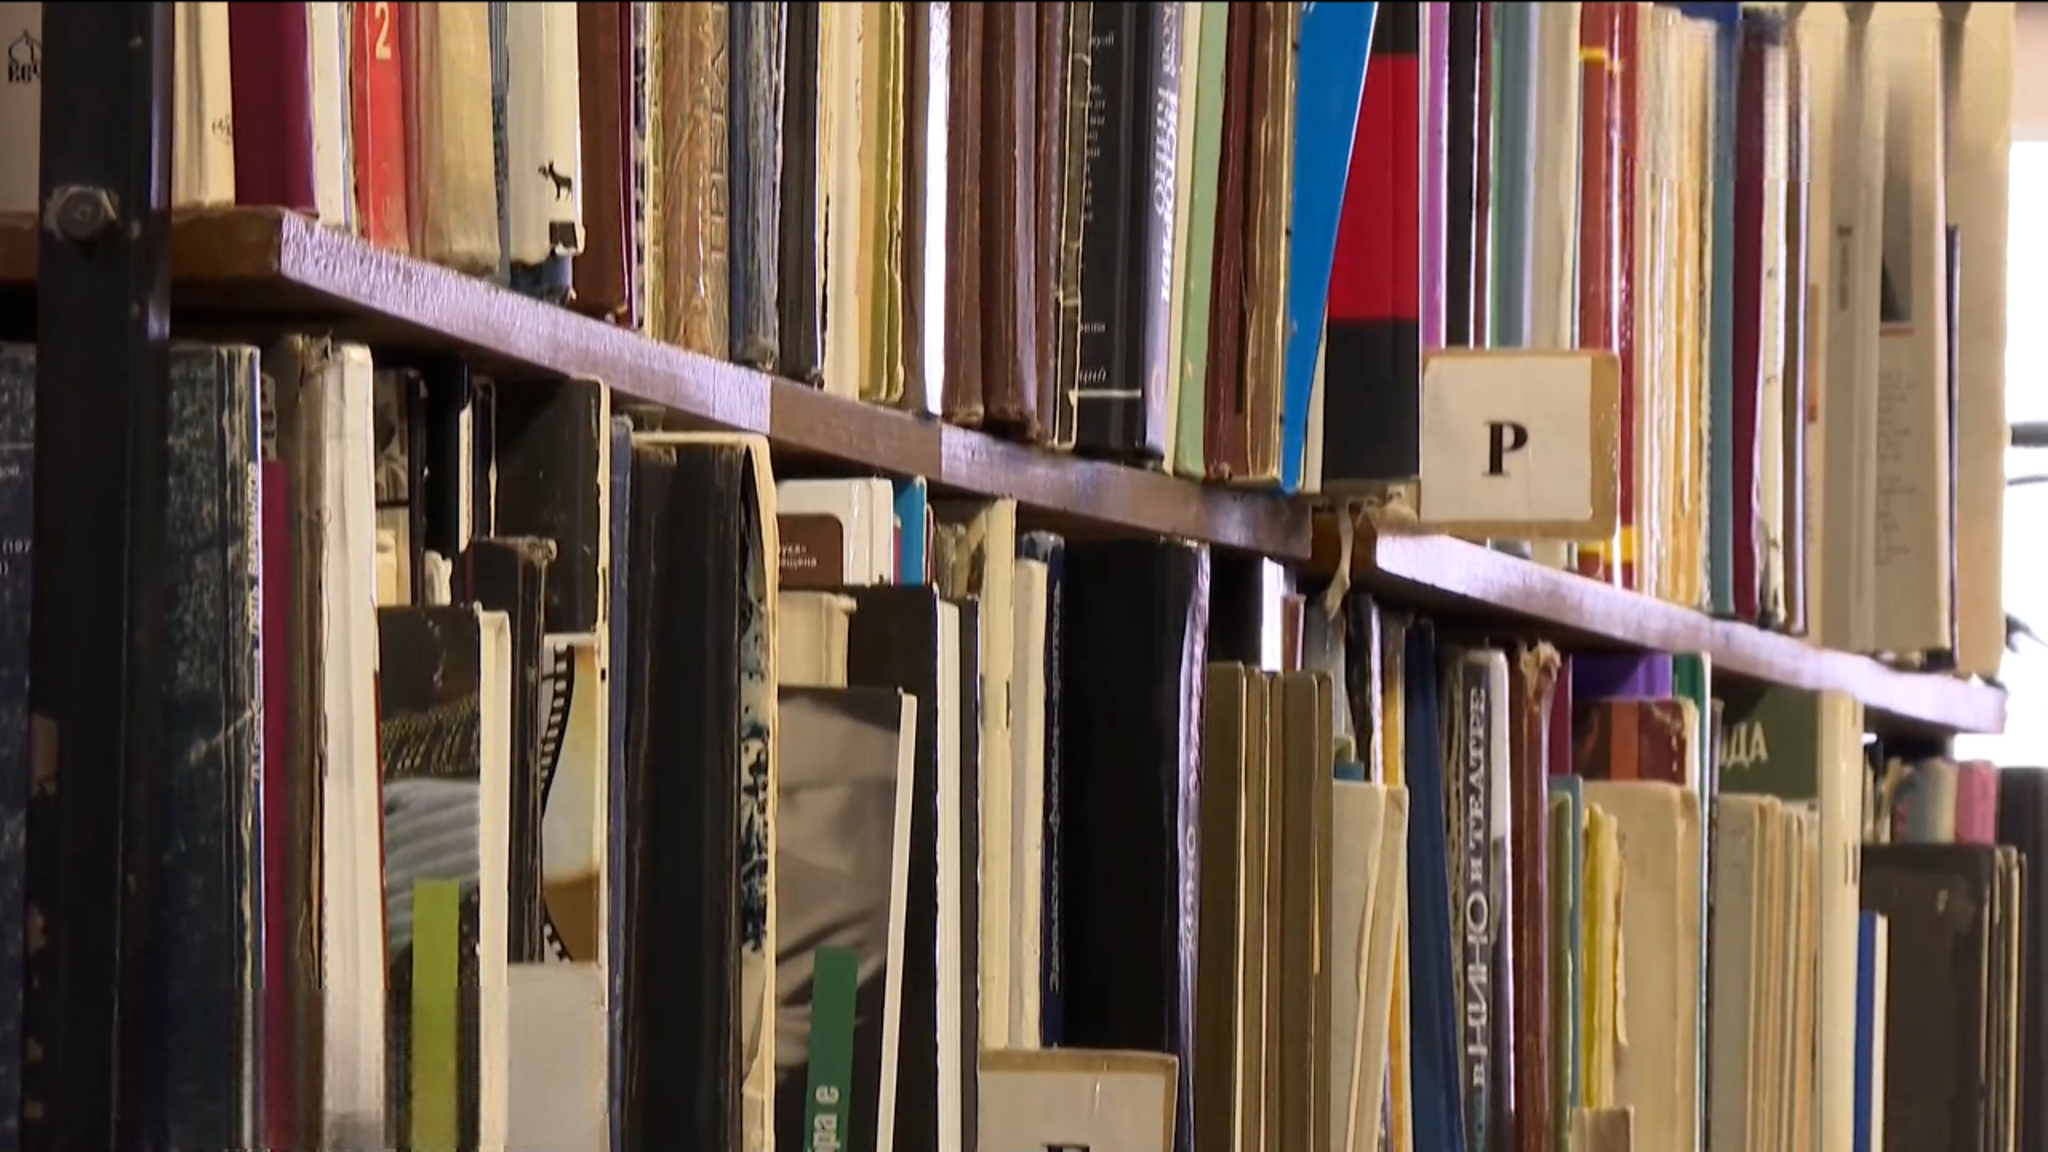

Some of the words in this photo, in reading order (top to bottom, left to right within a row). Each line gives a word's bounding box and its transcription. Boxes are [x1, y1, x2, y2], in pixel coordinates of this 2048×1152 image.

[375, 2, 391, 60] 2
[1481, 419, 1529, 478] Р
[1469, 688, 1486, 849] ТЕАТРЕ
